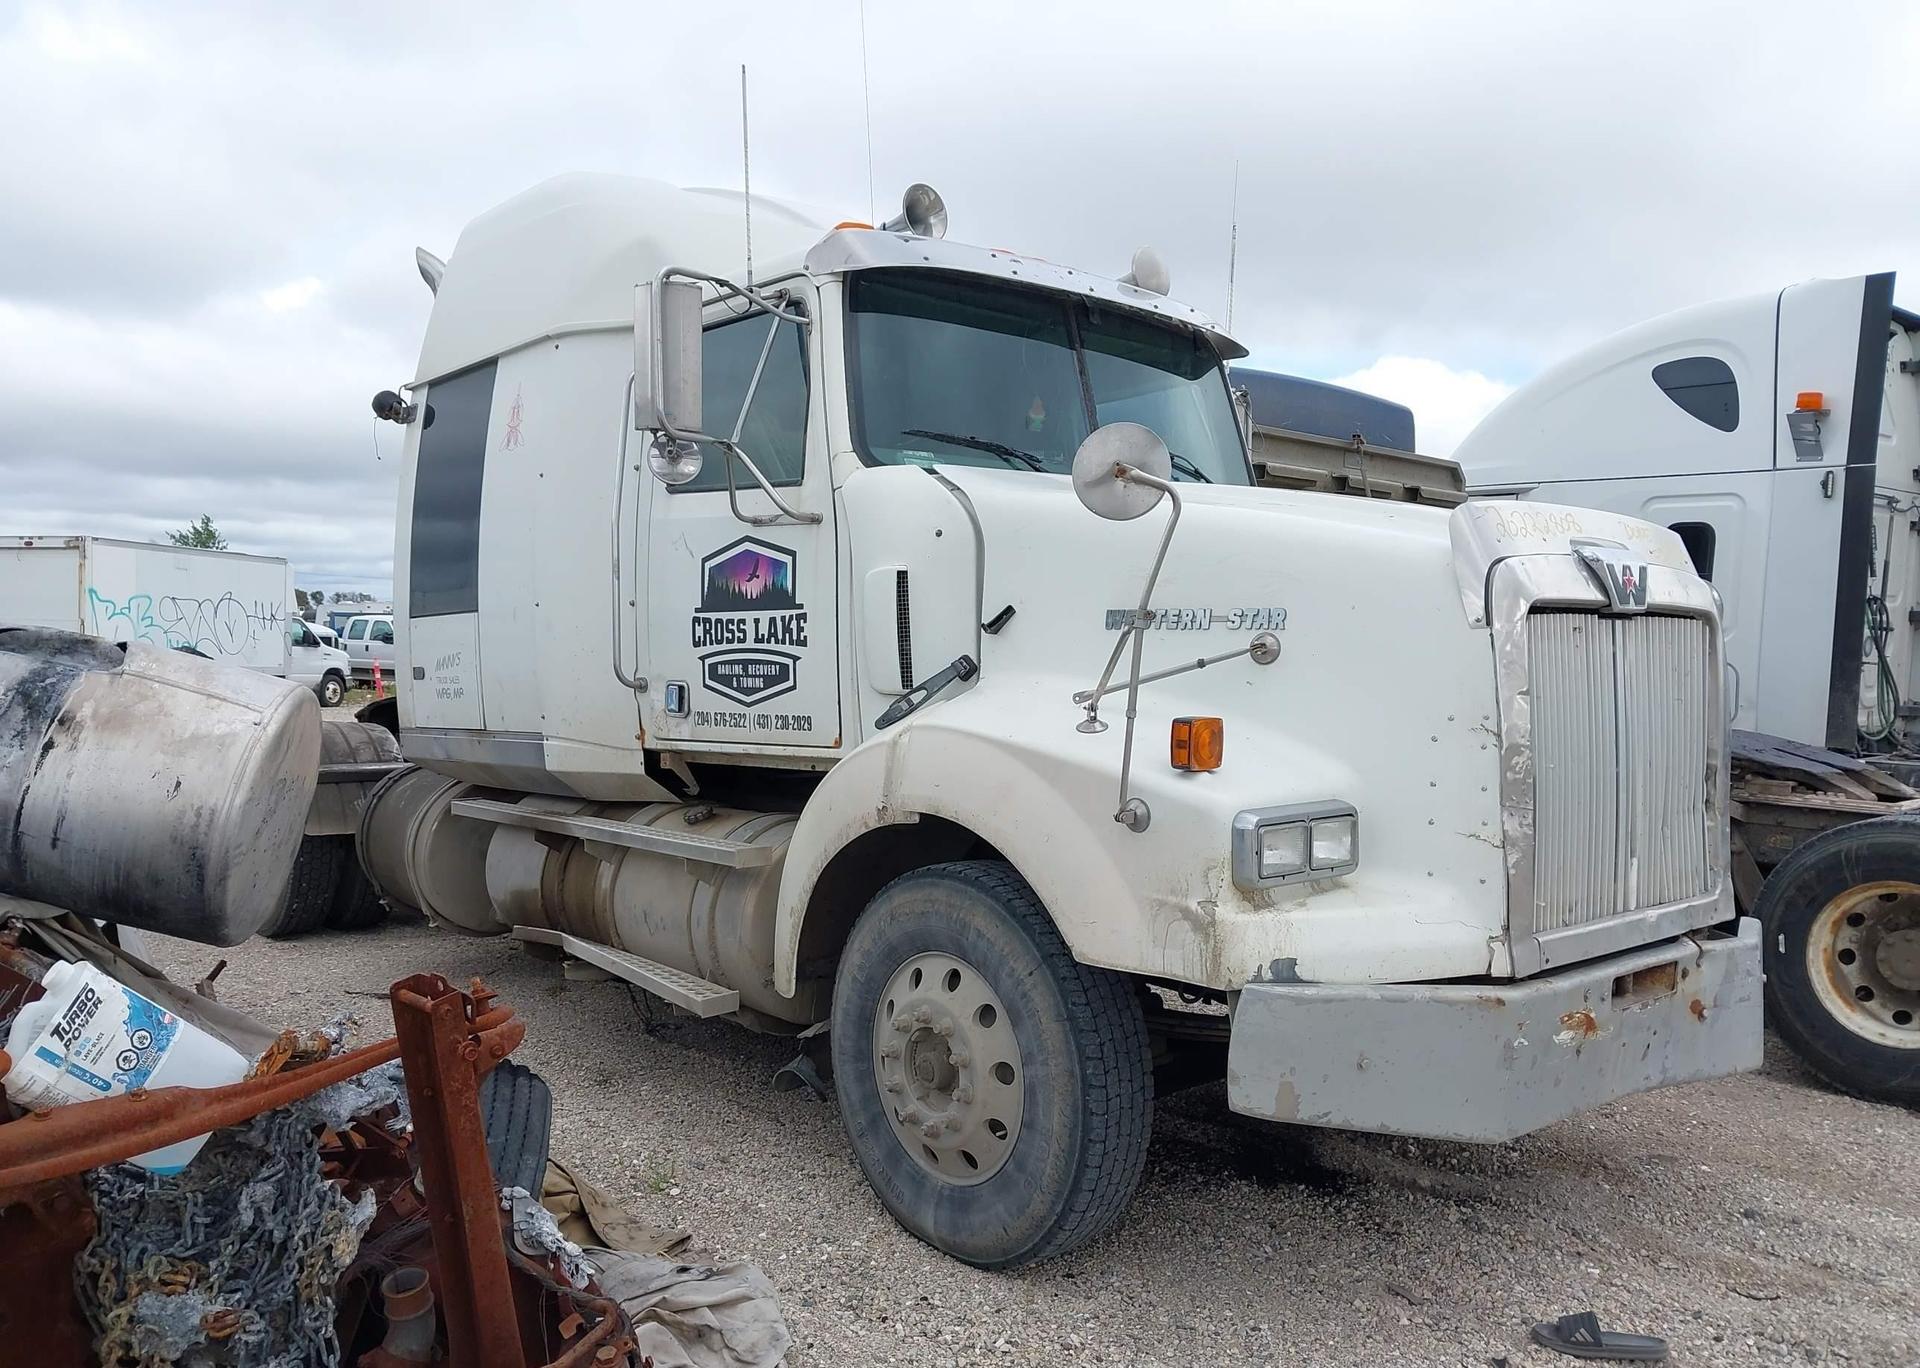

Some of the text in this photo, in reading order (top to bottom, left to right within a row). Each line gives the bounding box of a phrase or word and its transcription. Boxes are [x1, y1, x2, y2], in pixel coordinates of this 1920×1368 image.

[692, 612, 808, 648] CROSS LAKE
[1226, 608, 1287, 630] STAR
[717, 664, 780, 676] HAULING, RECOVERY
[732, 677, 764, 688] & TOWING
[693, 711, 812, 732] (204) 676-2522 (431) 230-2029
[50, 987, 96, 1043] TURBO
[63, 996, 103, 1052] POWER
[138, 1043, 157, 1069] DANGER
